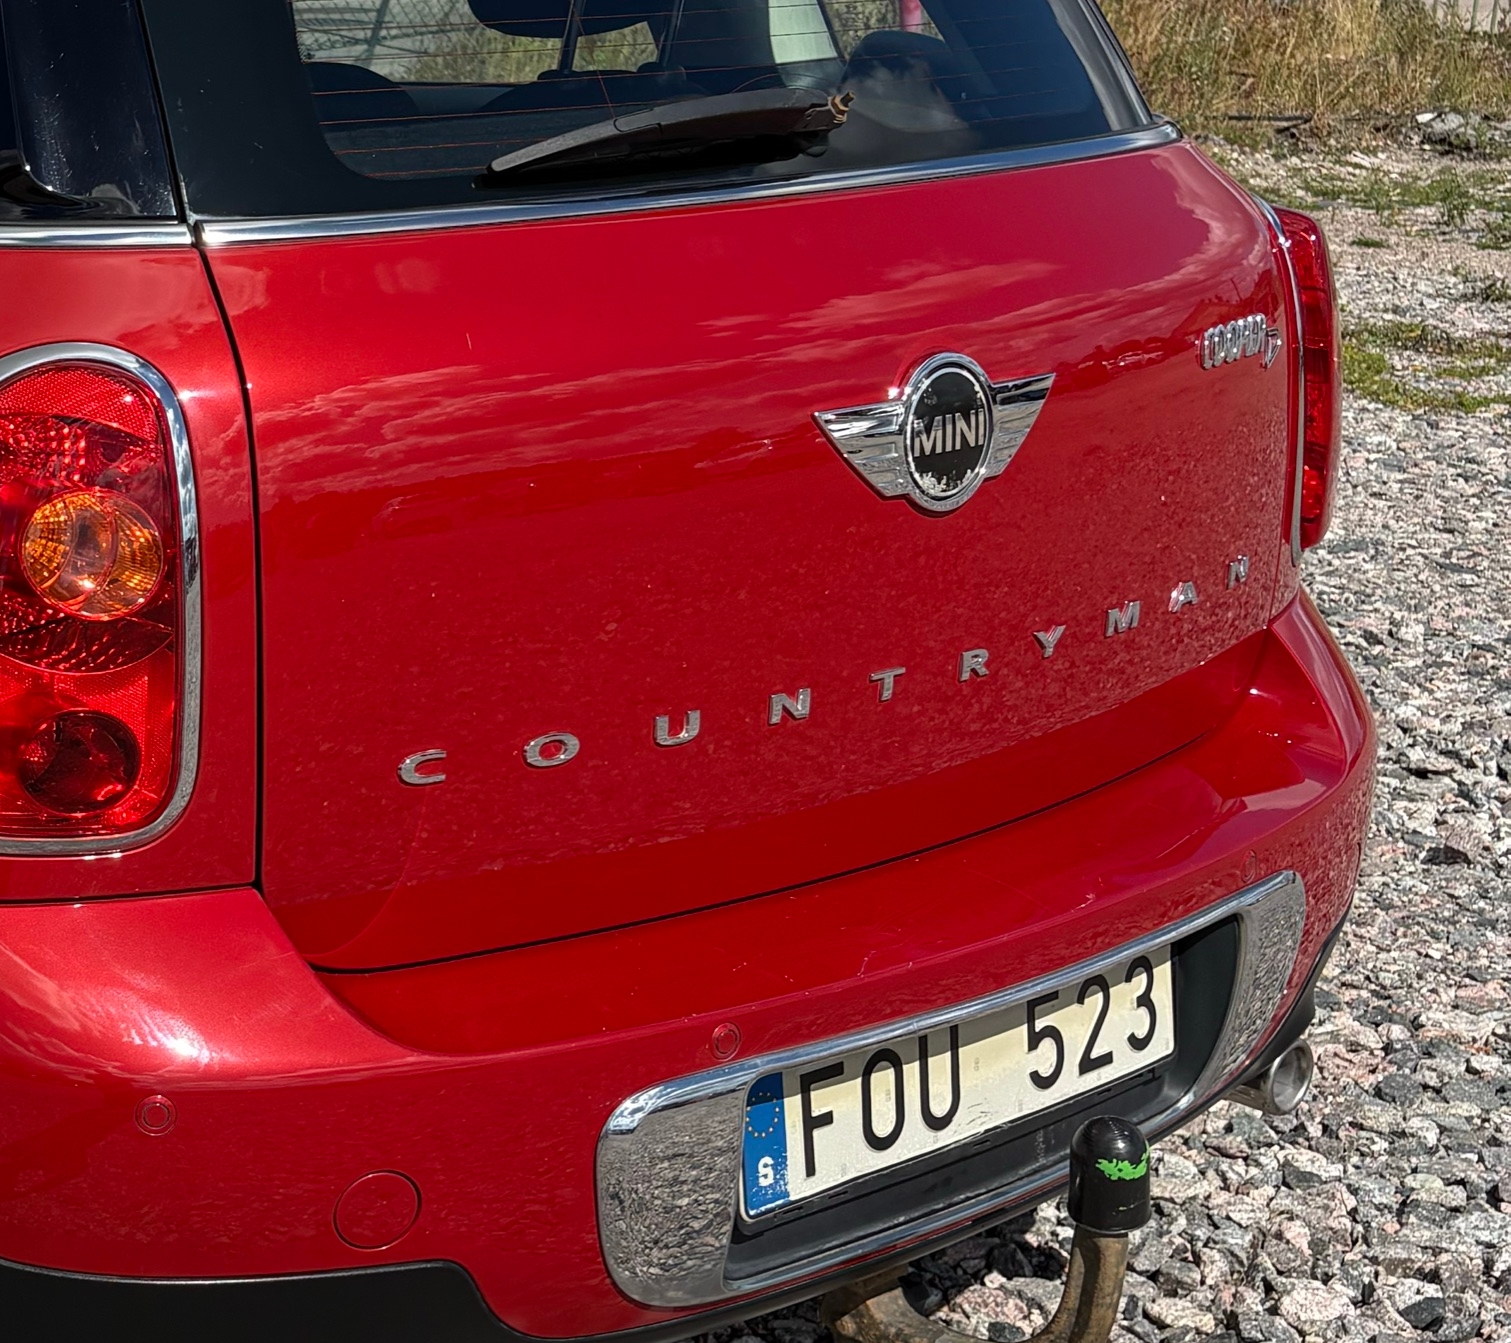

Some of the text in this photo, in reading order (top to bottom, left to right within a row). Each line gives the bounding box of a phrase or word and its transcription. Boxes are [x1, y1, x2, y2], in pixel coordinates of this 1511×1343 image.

[913, 407, 985, 457] MINI
[397, 554, 1250, 787] COUNTRYMAN
[799, 955, 1157, 1178] FOU 523
[757, 1156, 775, 1187] S
